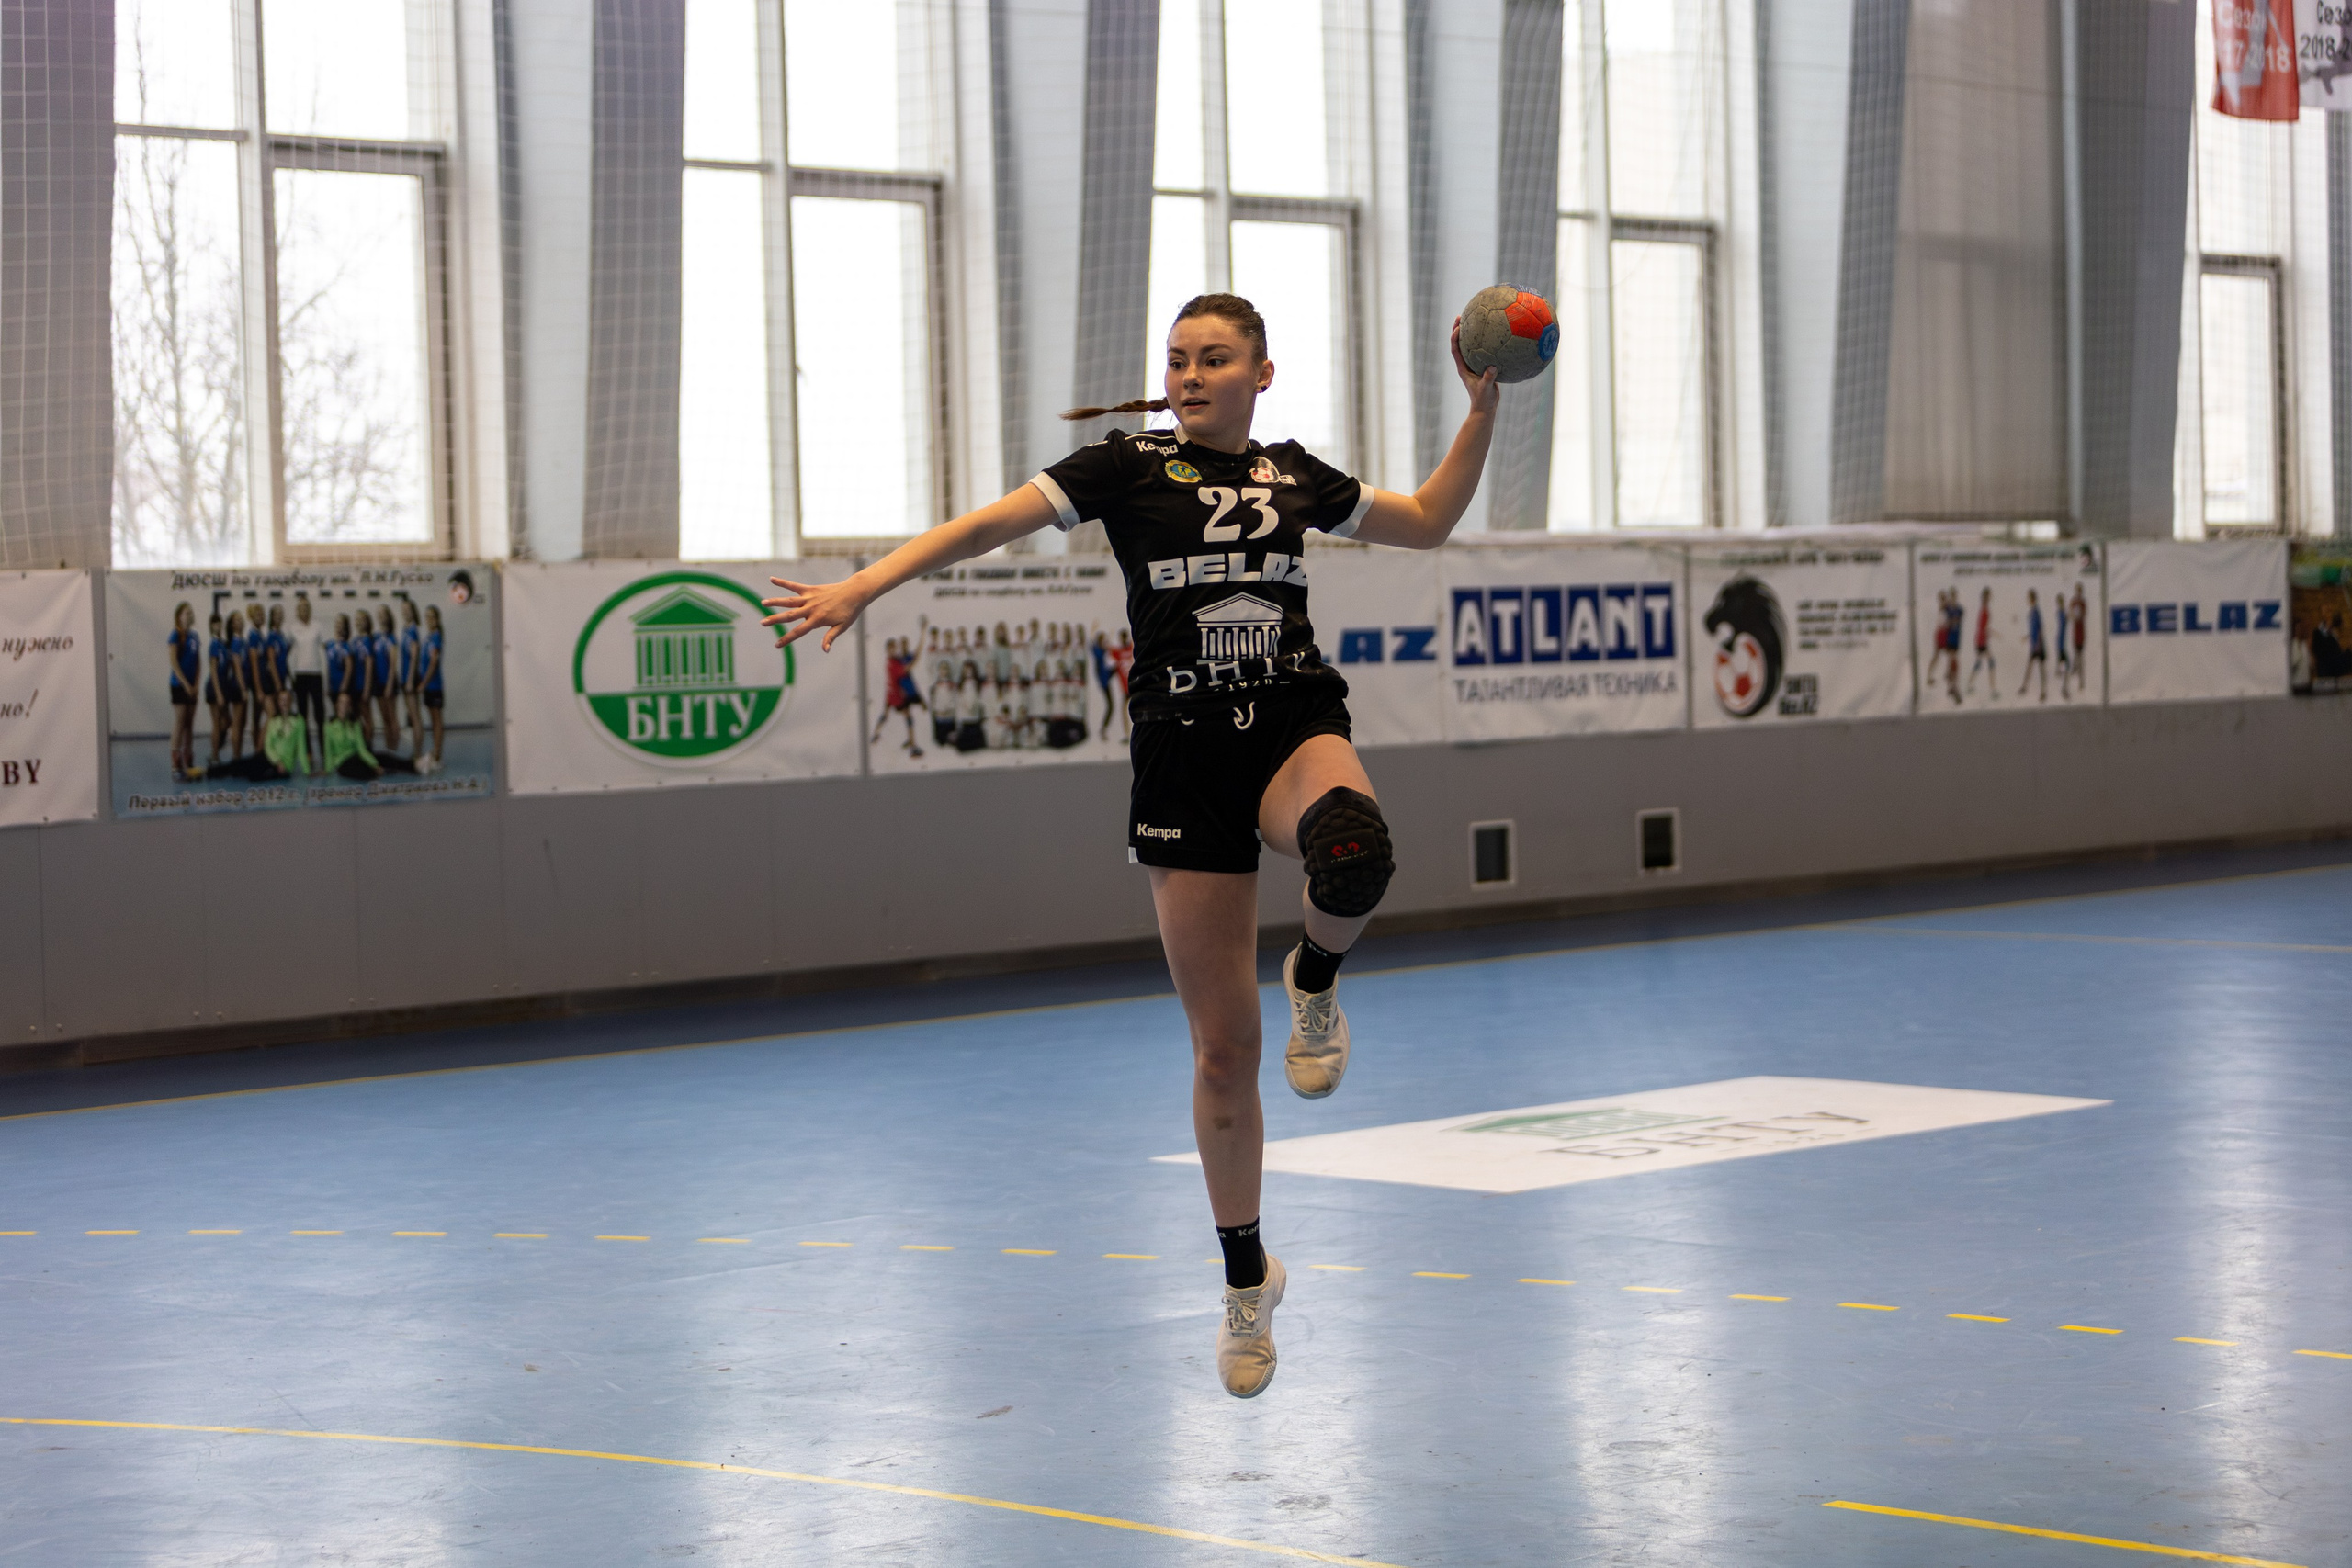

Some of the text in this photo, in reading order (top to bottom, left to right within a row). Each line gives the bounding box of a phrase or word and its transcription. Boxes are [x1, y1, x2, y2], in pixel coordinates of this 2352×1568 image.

[1197, 486, 1280, 543] 23
[172, 571, 227, 590] ДЮСШ
[1148, 552, 1308, 590] BELAZ
[1454, 592, 1672, 660] ATLANT
[2110, 599, 2282, 636] BELAZ
[1, 636, 74, 662] нужно
[626, 692, 759, 742] БНТУ
[1136, 823, 1182, 841] Kempa
